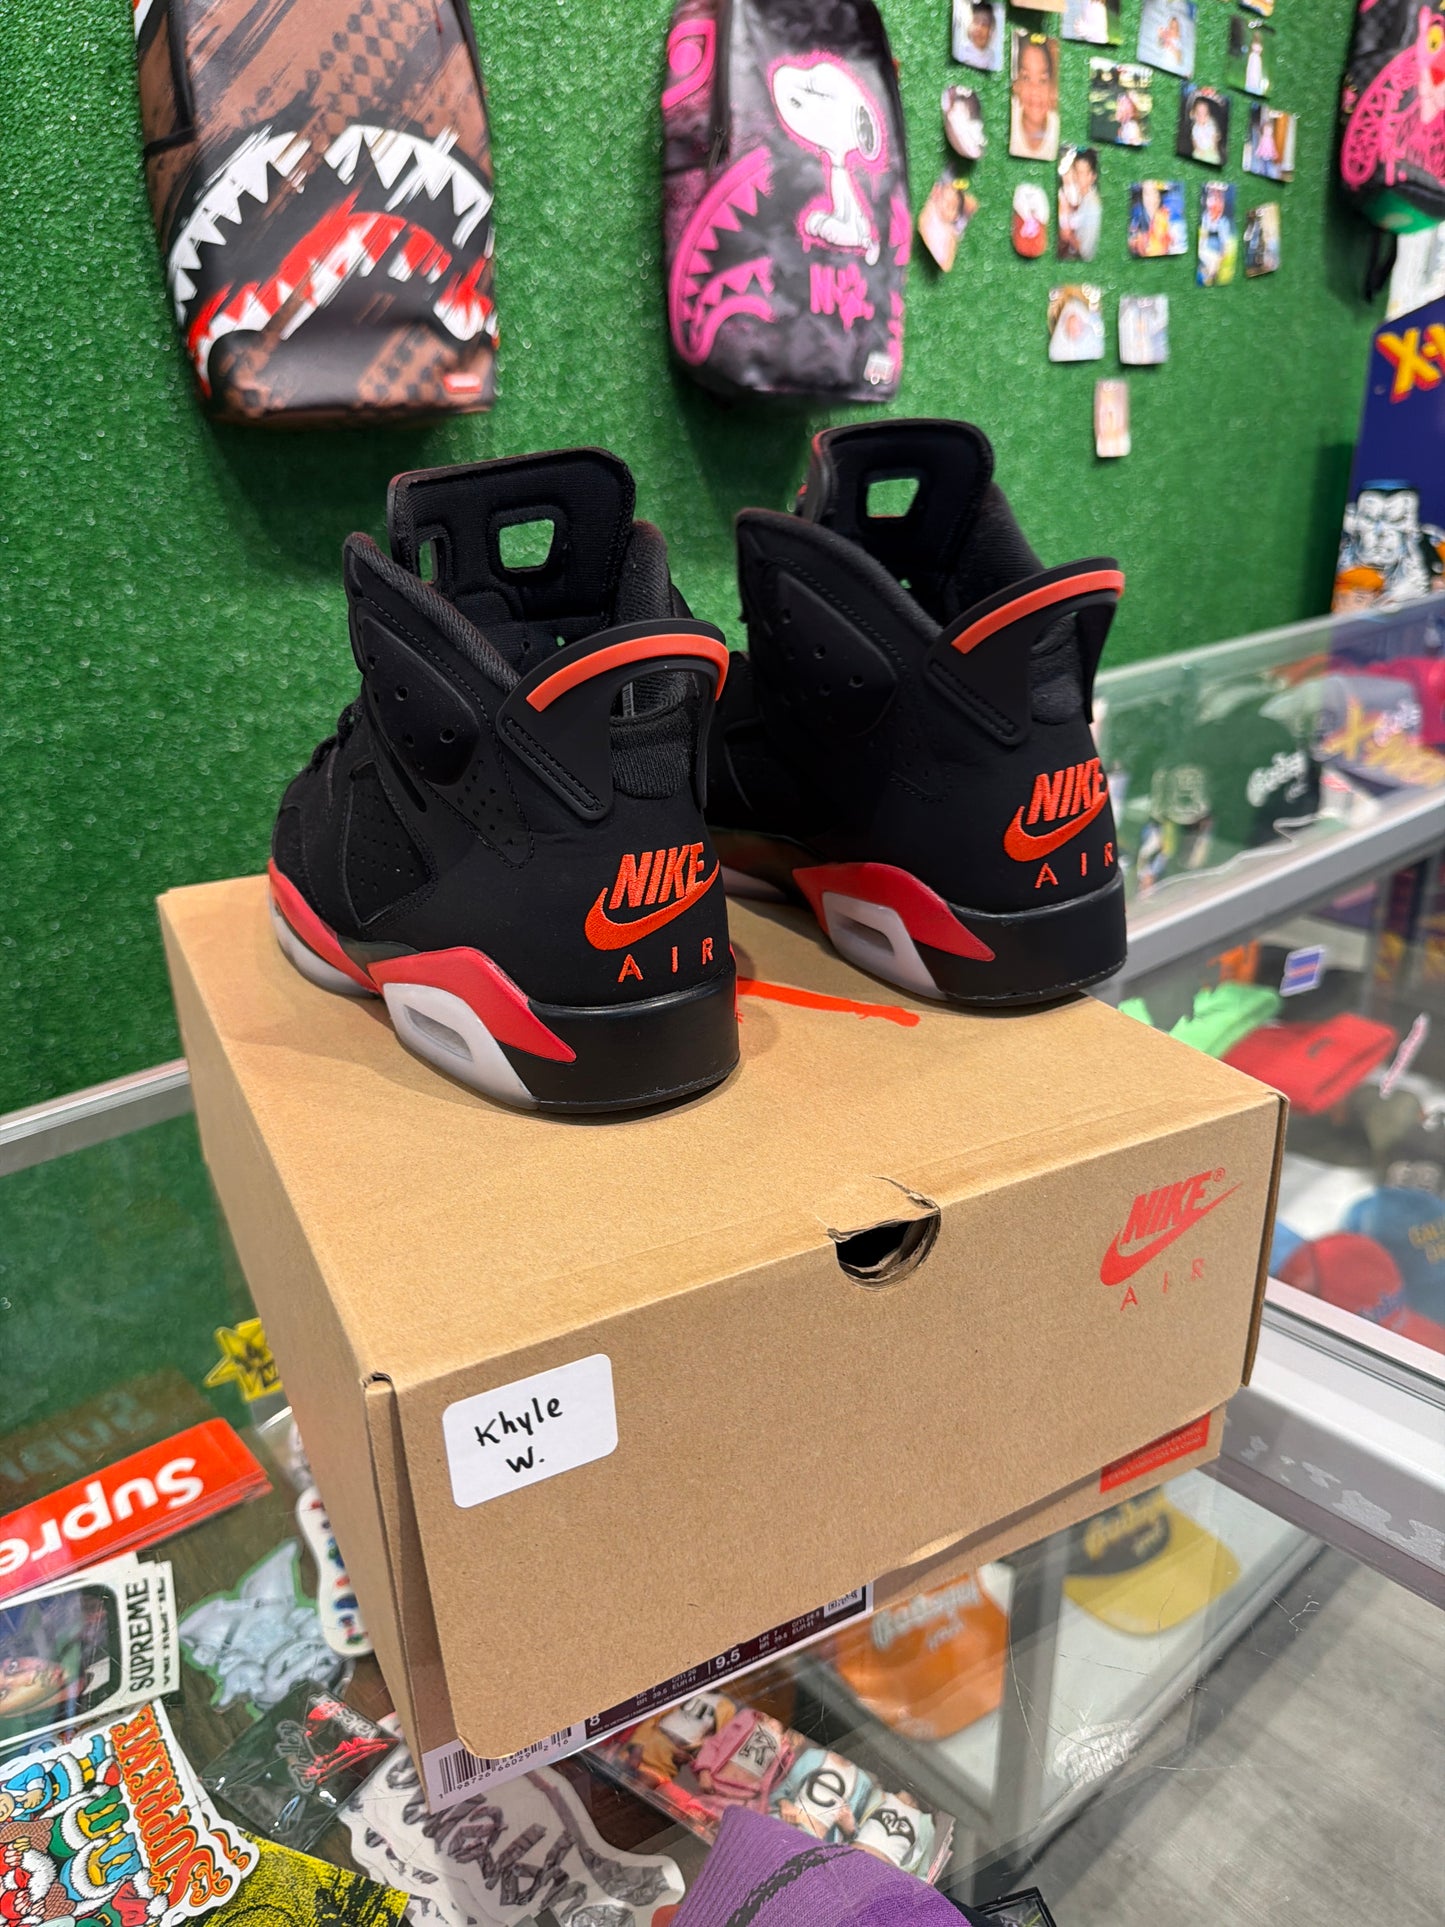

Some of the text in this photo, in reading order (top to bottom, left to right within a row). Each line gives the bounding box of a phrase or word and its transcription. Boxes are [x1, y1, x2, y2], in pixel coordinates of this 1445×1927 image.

[1025, 757, 1104, 825] NIKE
[609, 842, 704, 909] NIKE
[1034, 842, 1113, 888] AIR
[618, 937, 713, 982] AIR
[1120, 1258, 1205, 1311] AIR
[474, 1397, 563, 1447] Khyle
[505, 1446, 545, 1473] W.
[126, 1577, 155, 1692] SUPREME
[715, 1648, 741, 1669] 9.5
[589, 1713, 600, 1727] 8
